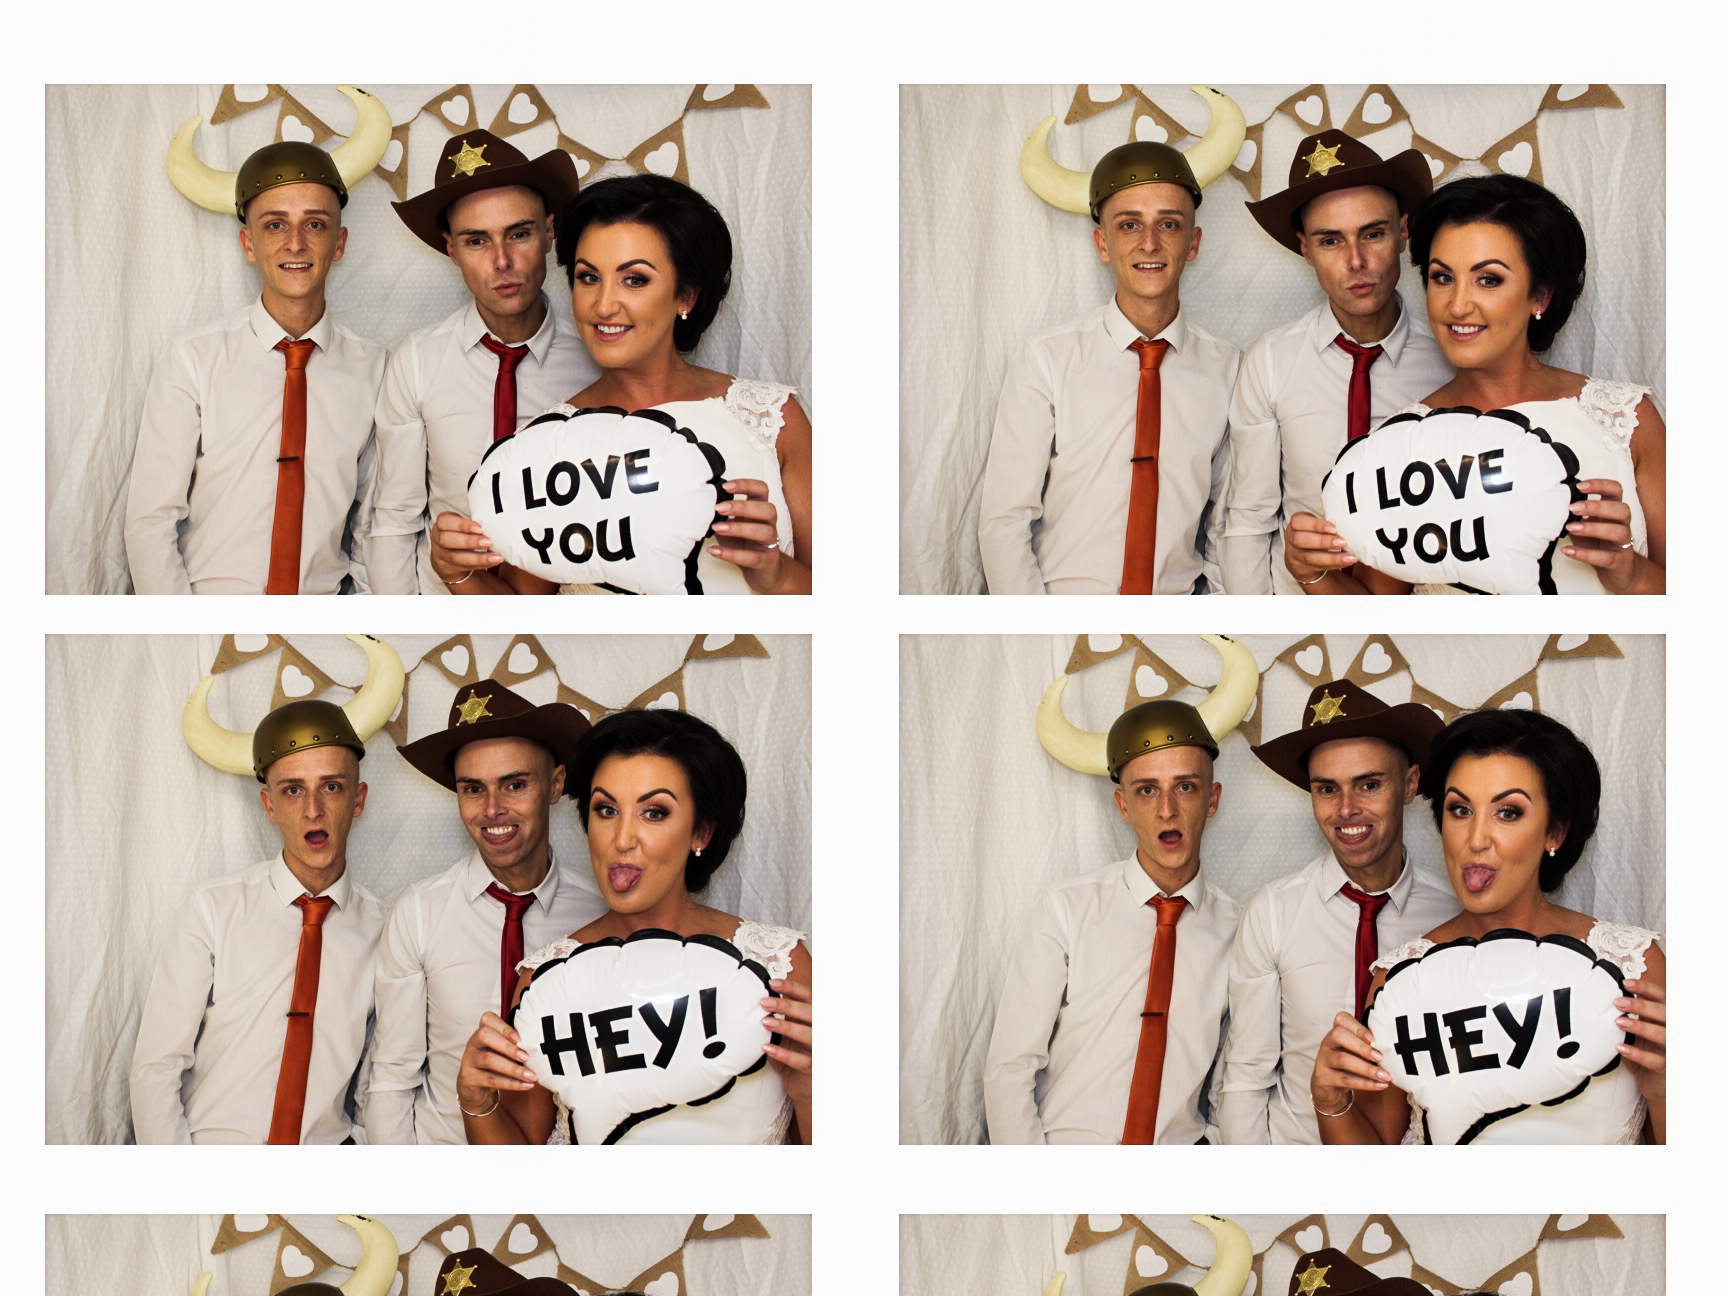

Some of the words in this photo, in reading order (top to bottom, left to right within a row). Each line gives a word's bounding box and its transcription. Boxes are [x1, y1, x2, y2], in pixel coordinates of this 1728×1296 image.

[491, 471, 504, 515] I
[522, 448, 659, 510] LOVE
[1345, 471, 1358, 515] I
[1376, 448, 1513, 510] LOVE
[521, 515, 636, 565] YOU
[1375, 515, 1490, 565] YOU
[539, 986, 727, 1077] HEY!
[1393, 986, 1581, 1077] HEY!
